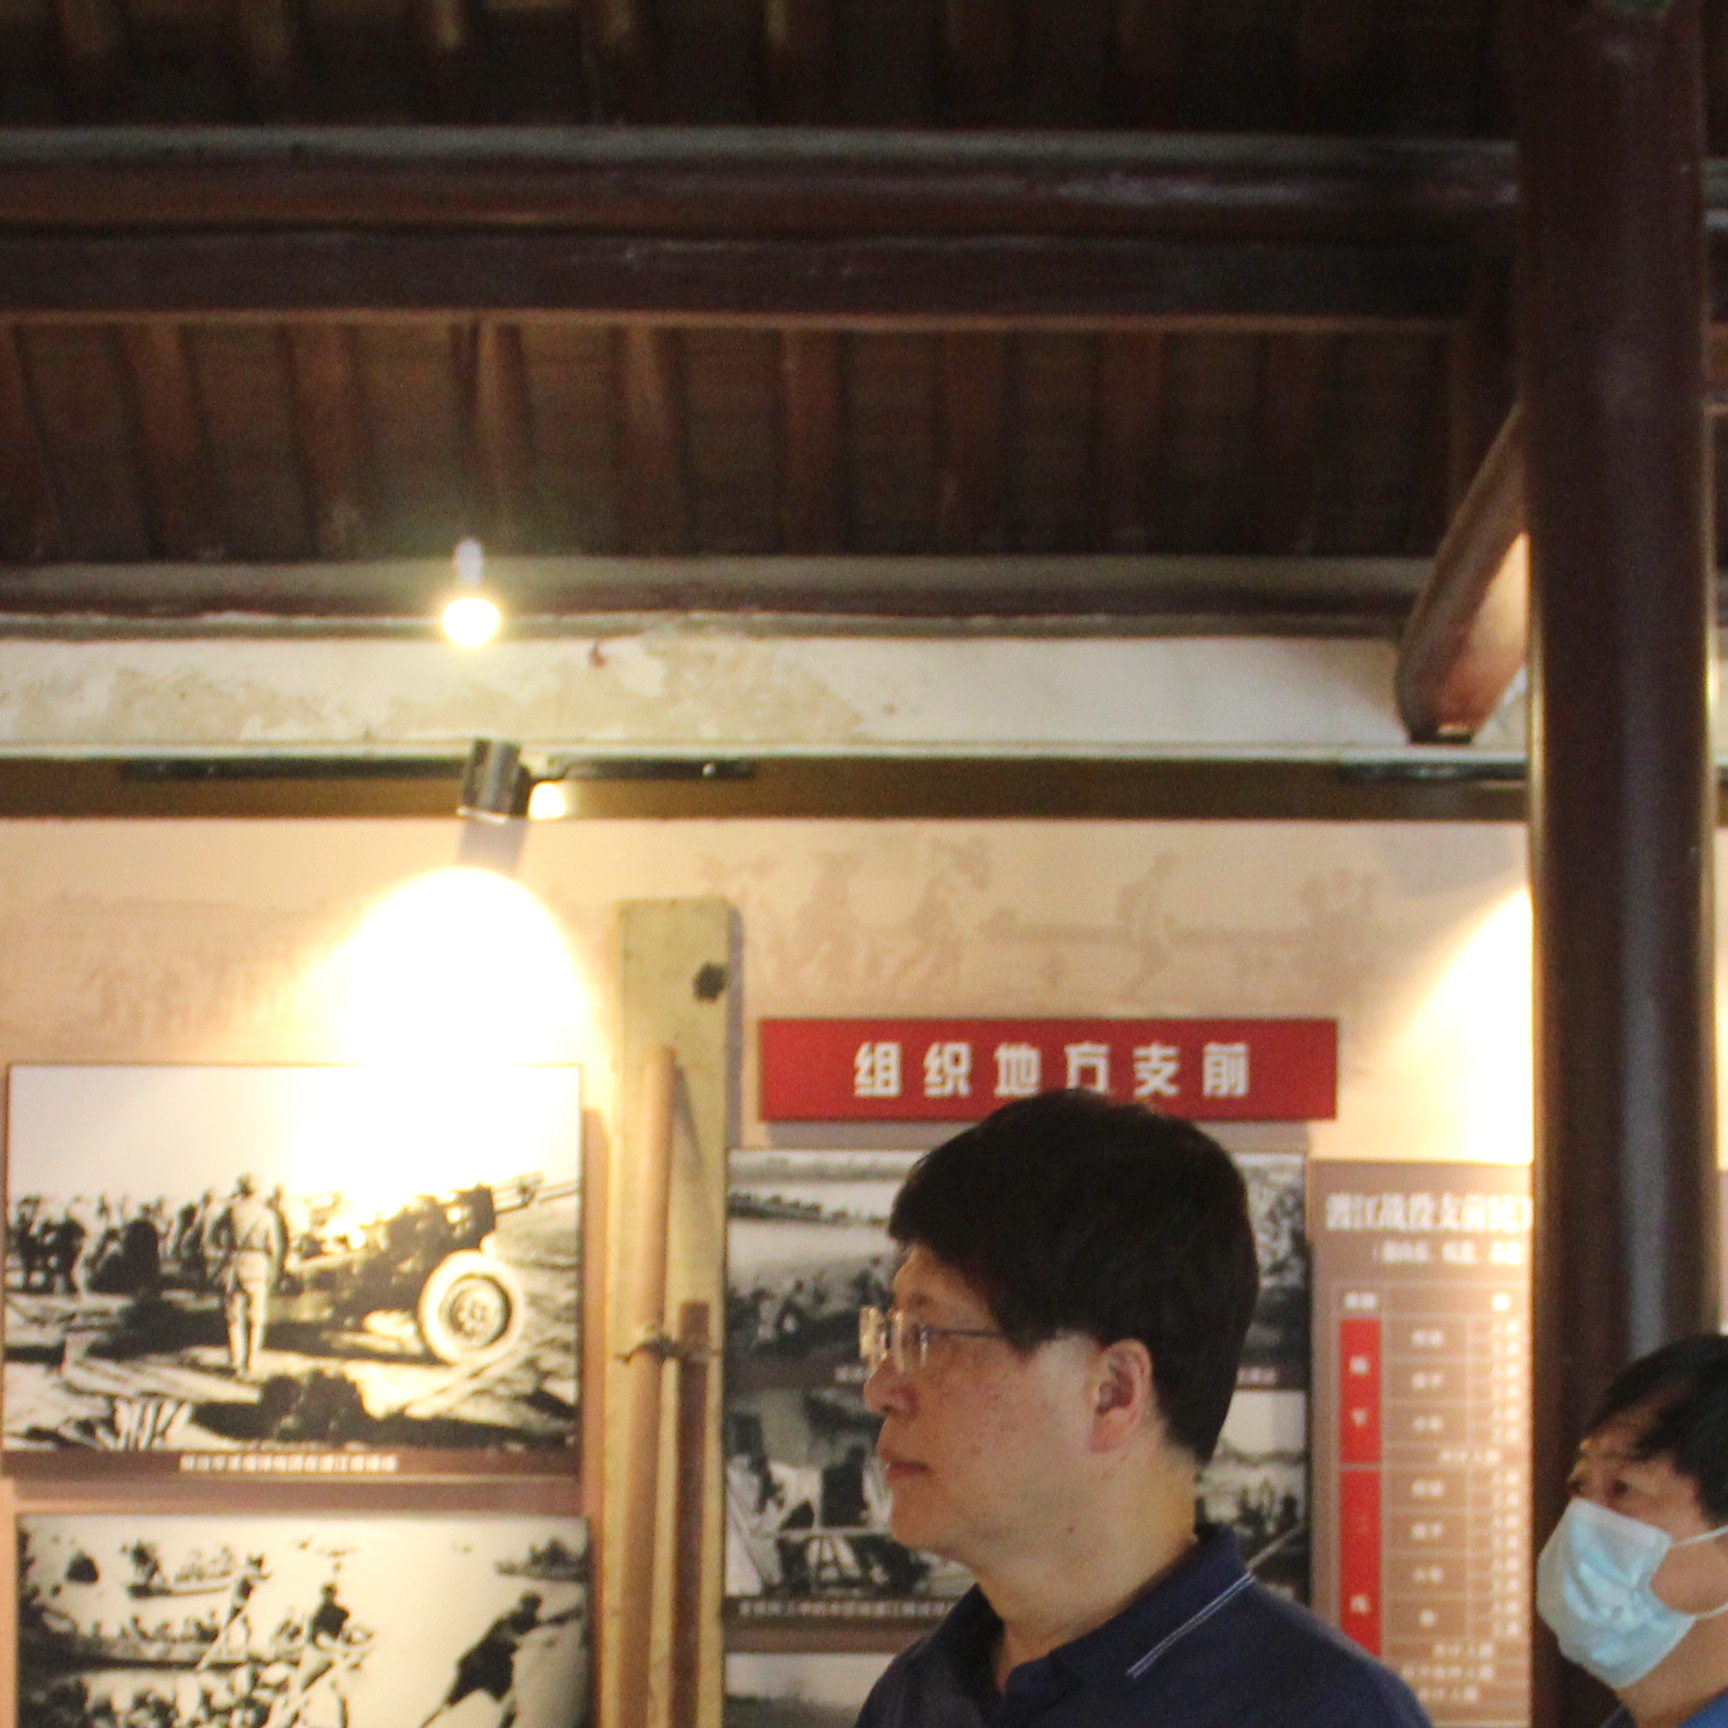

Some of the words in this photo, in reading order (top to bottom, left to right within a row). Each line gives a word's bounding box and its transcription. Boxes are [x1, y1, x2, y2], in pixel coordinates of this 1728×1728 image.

[853, 1040, 1250, 1099] 组织地方支前
